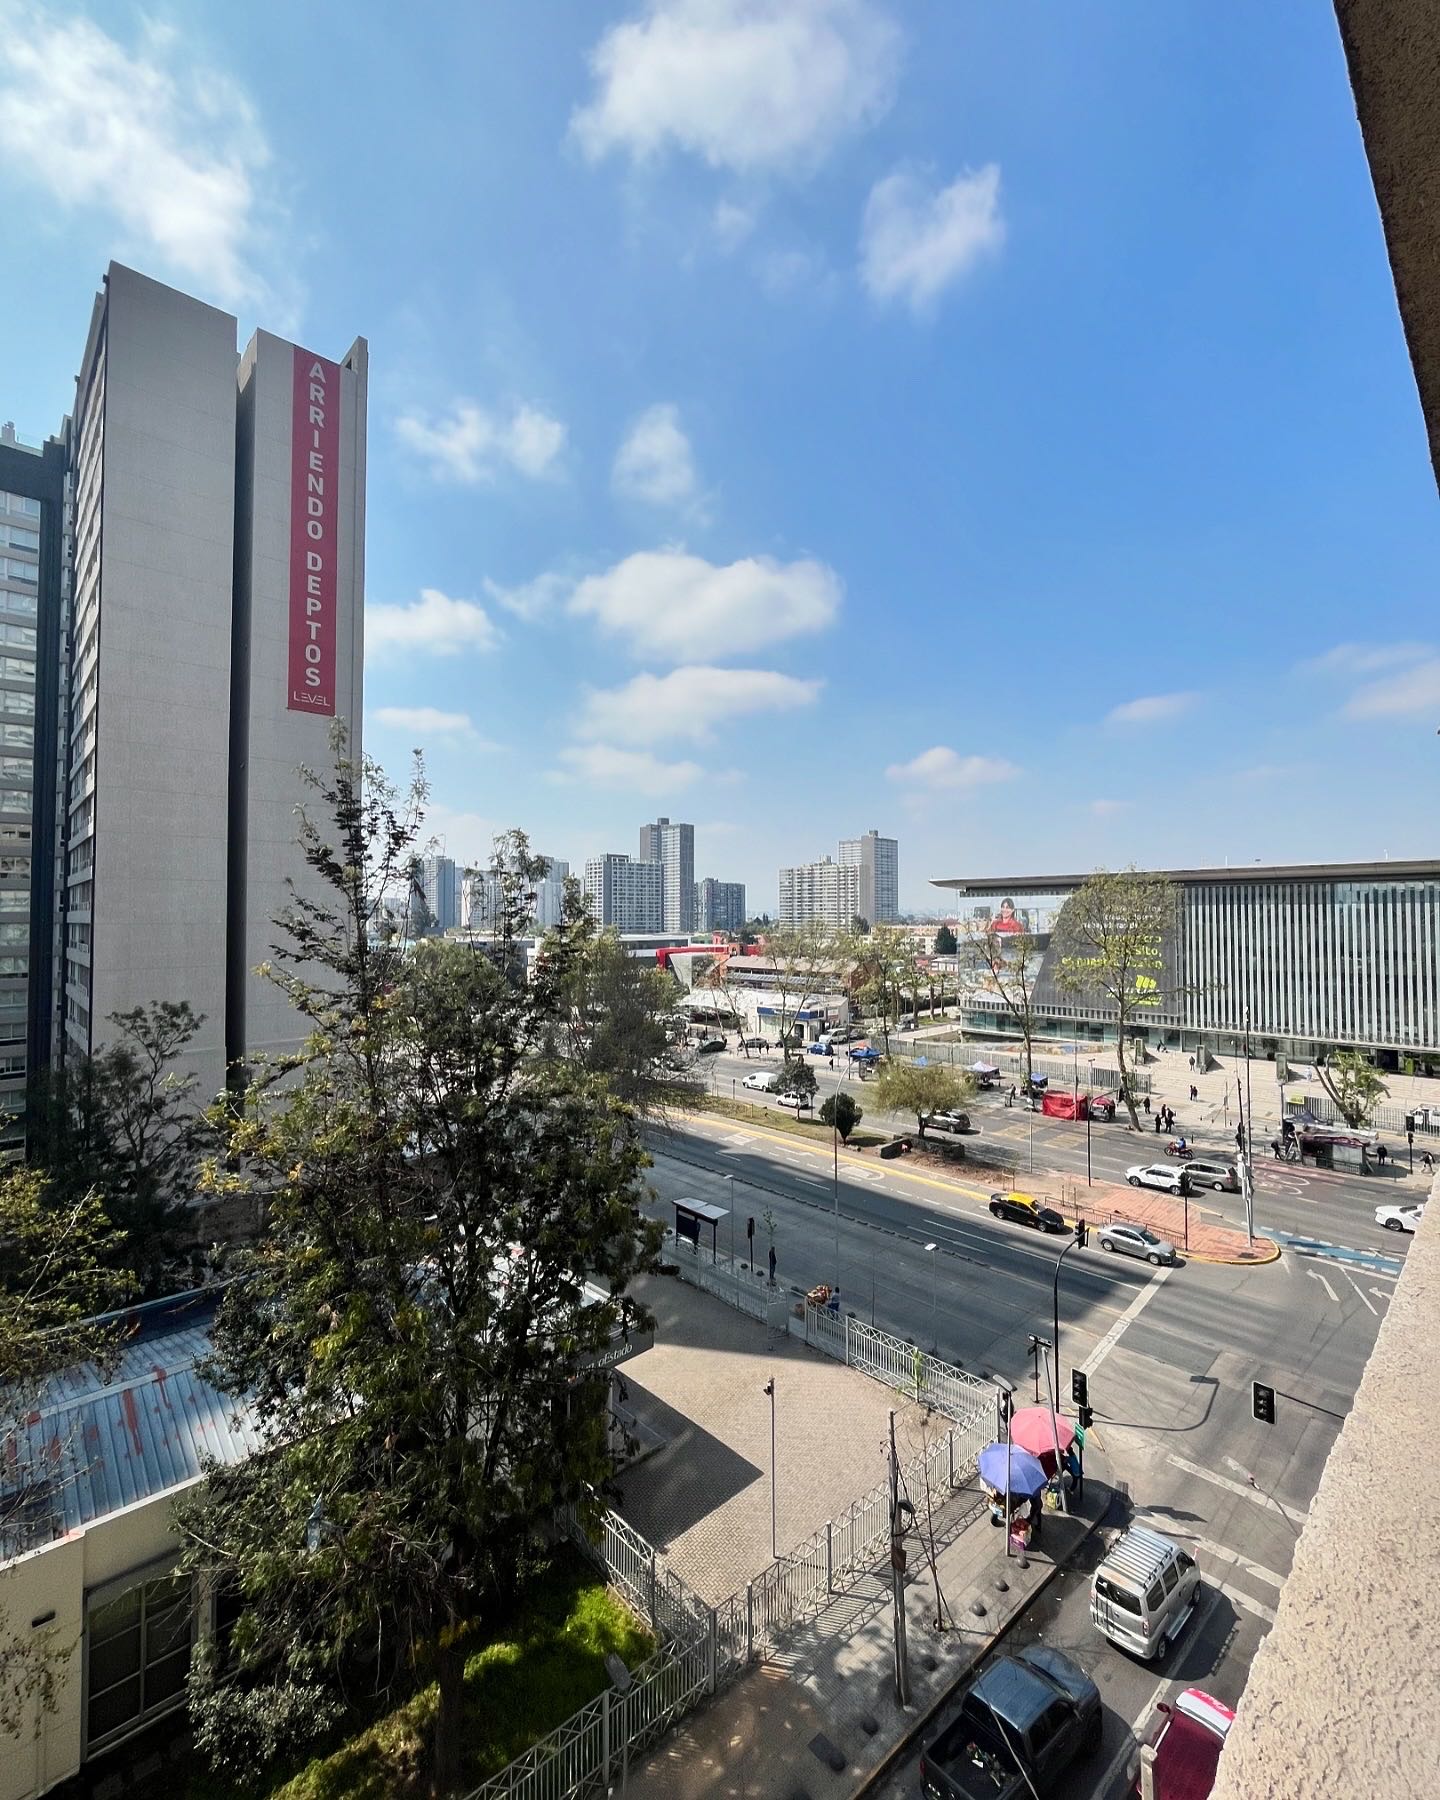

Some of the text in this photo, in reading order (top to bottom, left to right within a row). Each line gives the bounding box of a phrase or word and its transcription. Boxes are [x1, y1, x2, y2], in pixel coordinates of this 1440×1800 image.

[305, 361, 326, 687] ARRIENDO DEPTOS
[293, 691, 331, 707] LEVEL
[576, 1343, 633, 1378] noEstado
